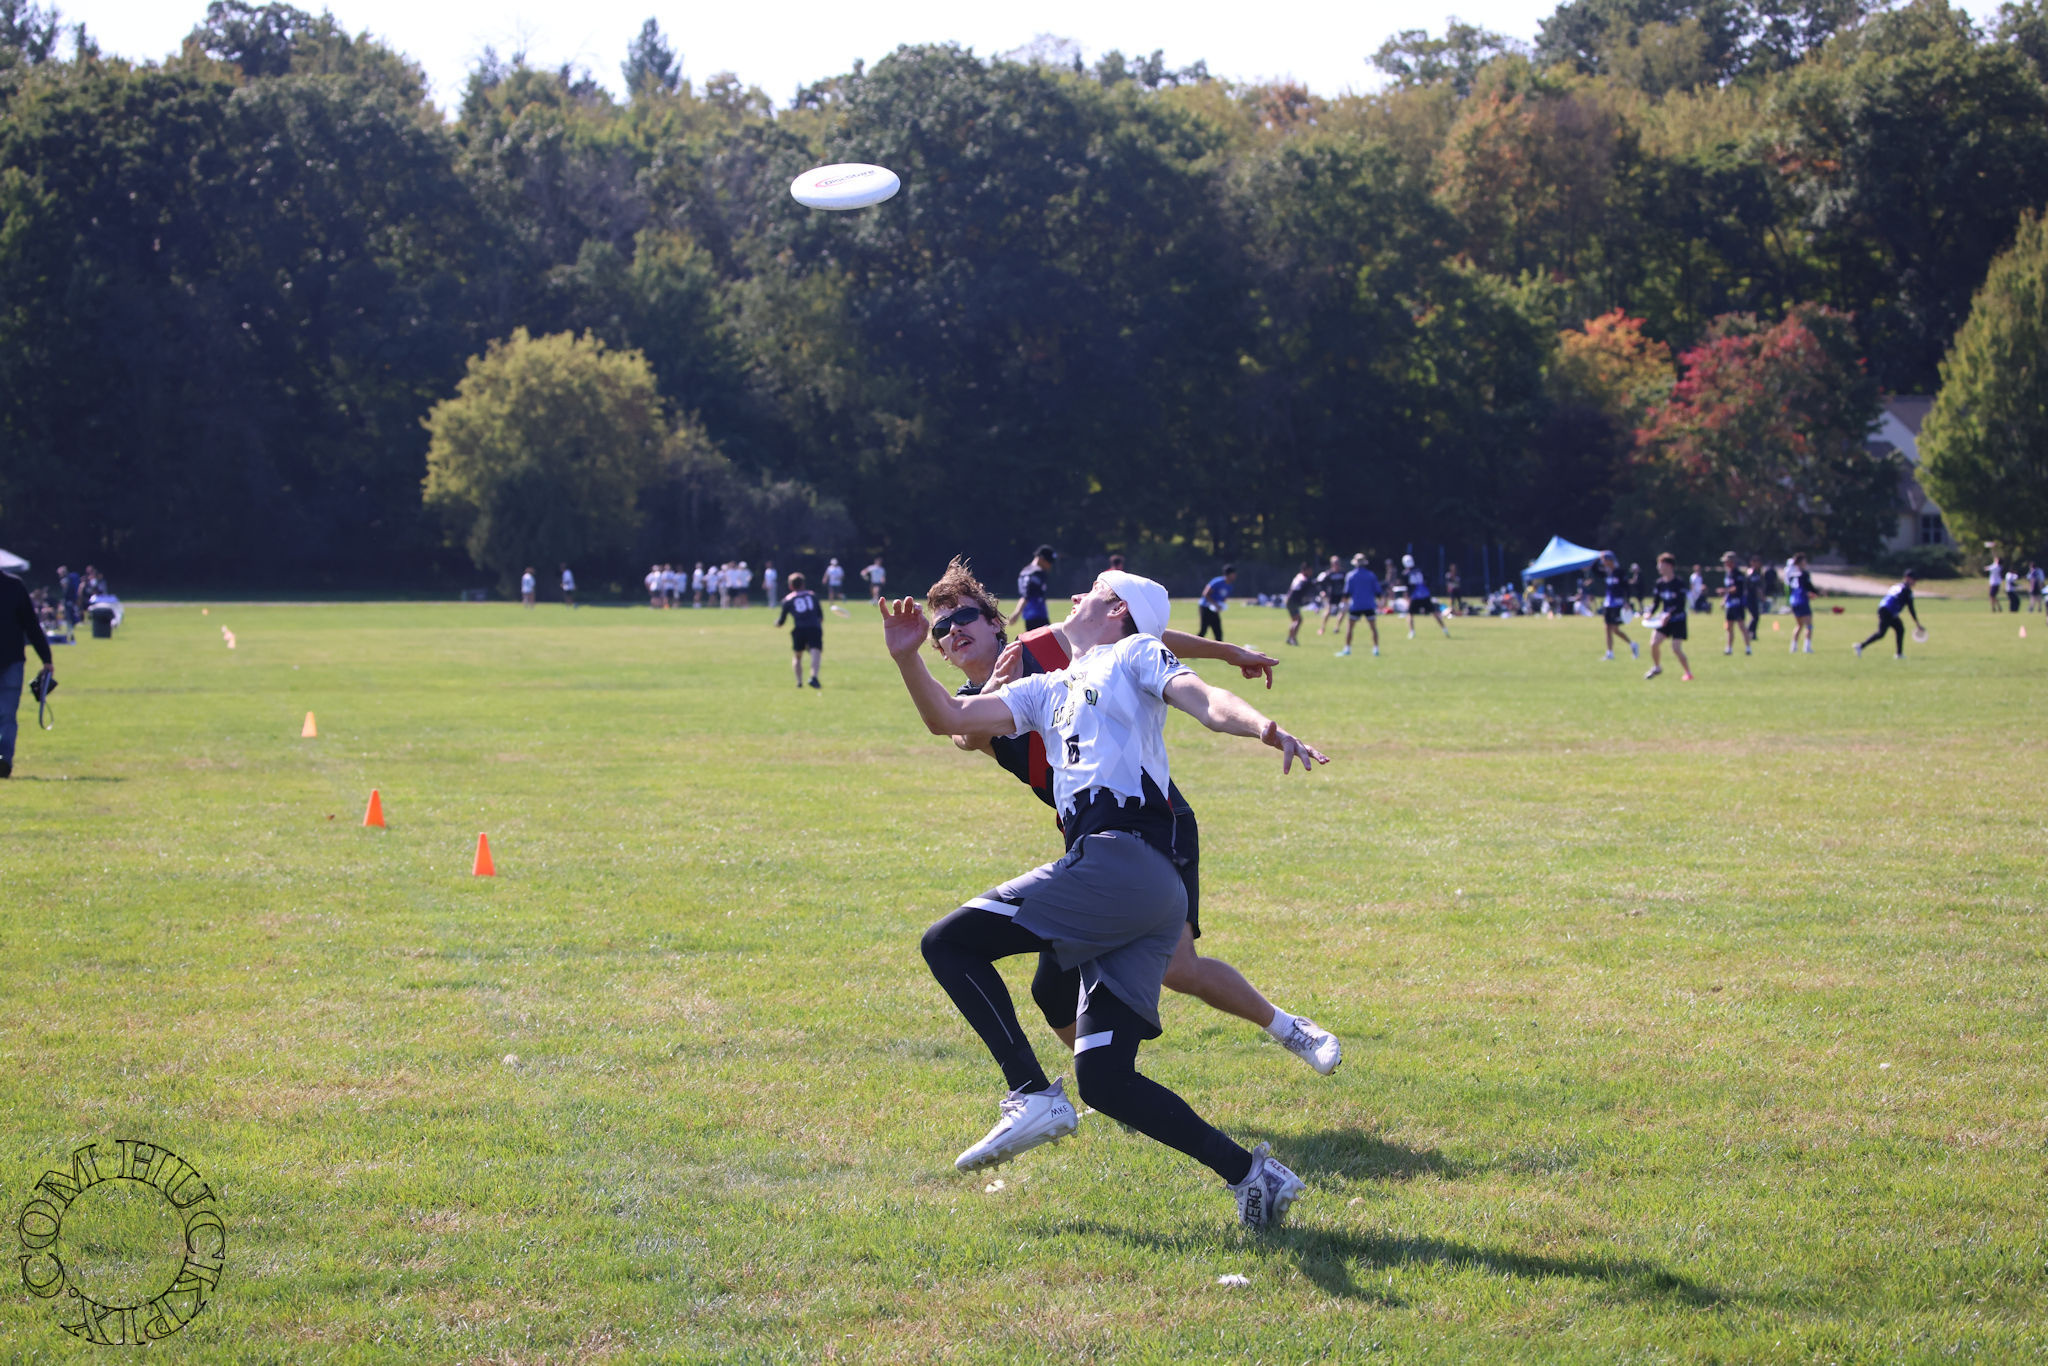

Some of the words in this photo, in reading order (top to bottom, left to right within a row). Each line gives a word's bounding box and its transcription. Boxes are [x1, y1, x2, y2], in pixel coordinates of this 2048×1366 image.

[793, 595, 815, 613] 81
[1050, 1104, 1070, 1118] MKE
[1268, 1159, 1288, 1176] ALEX
